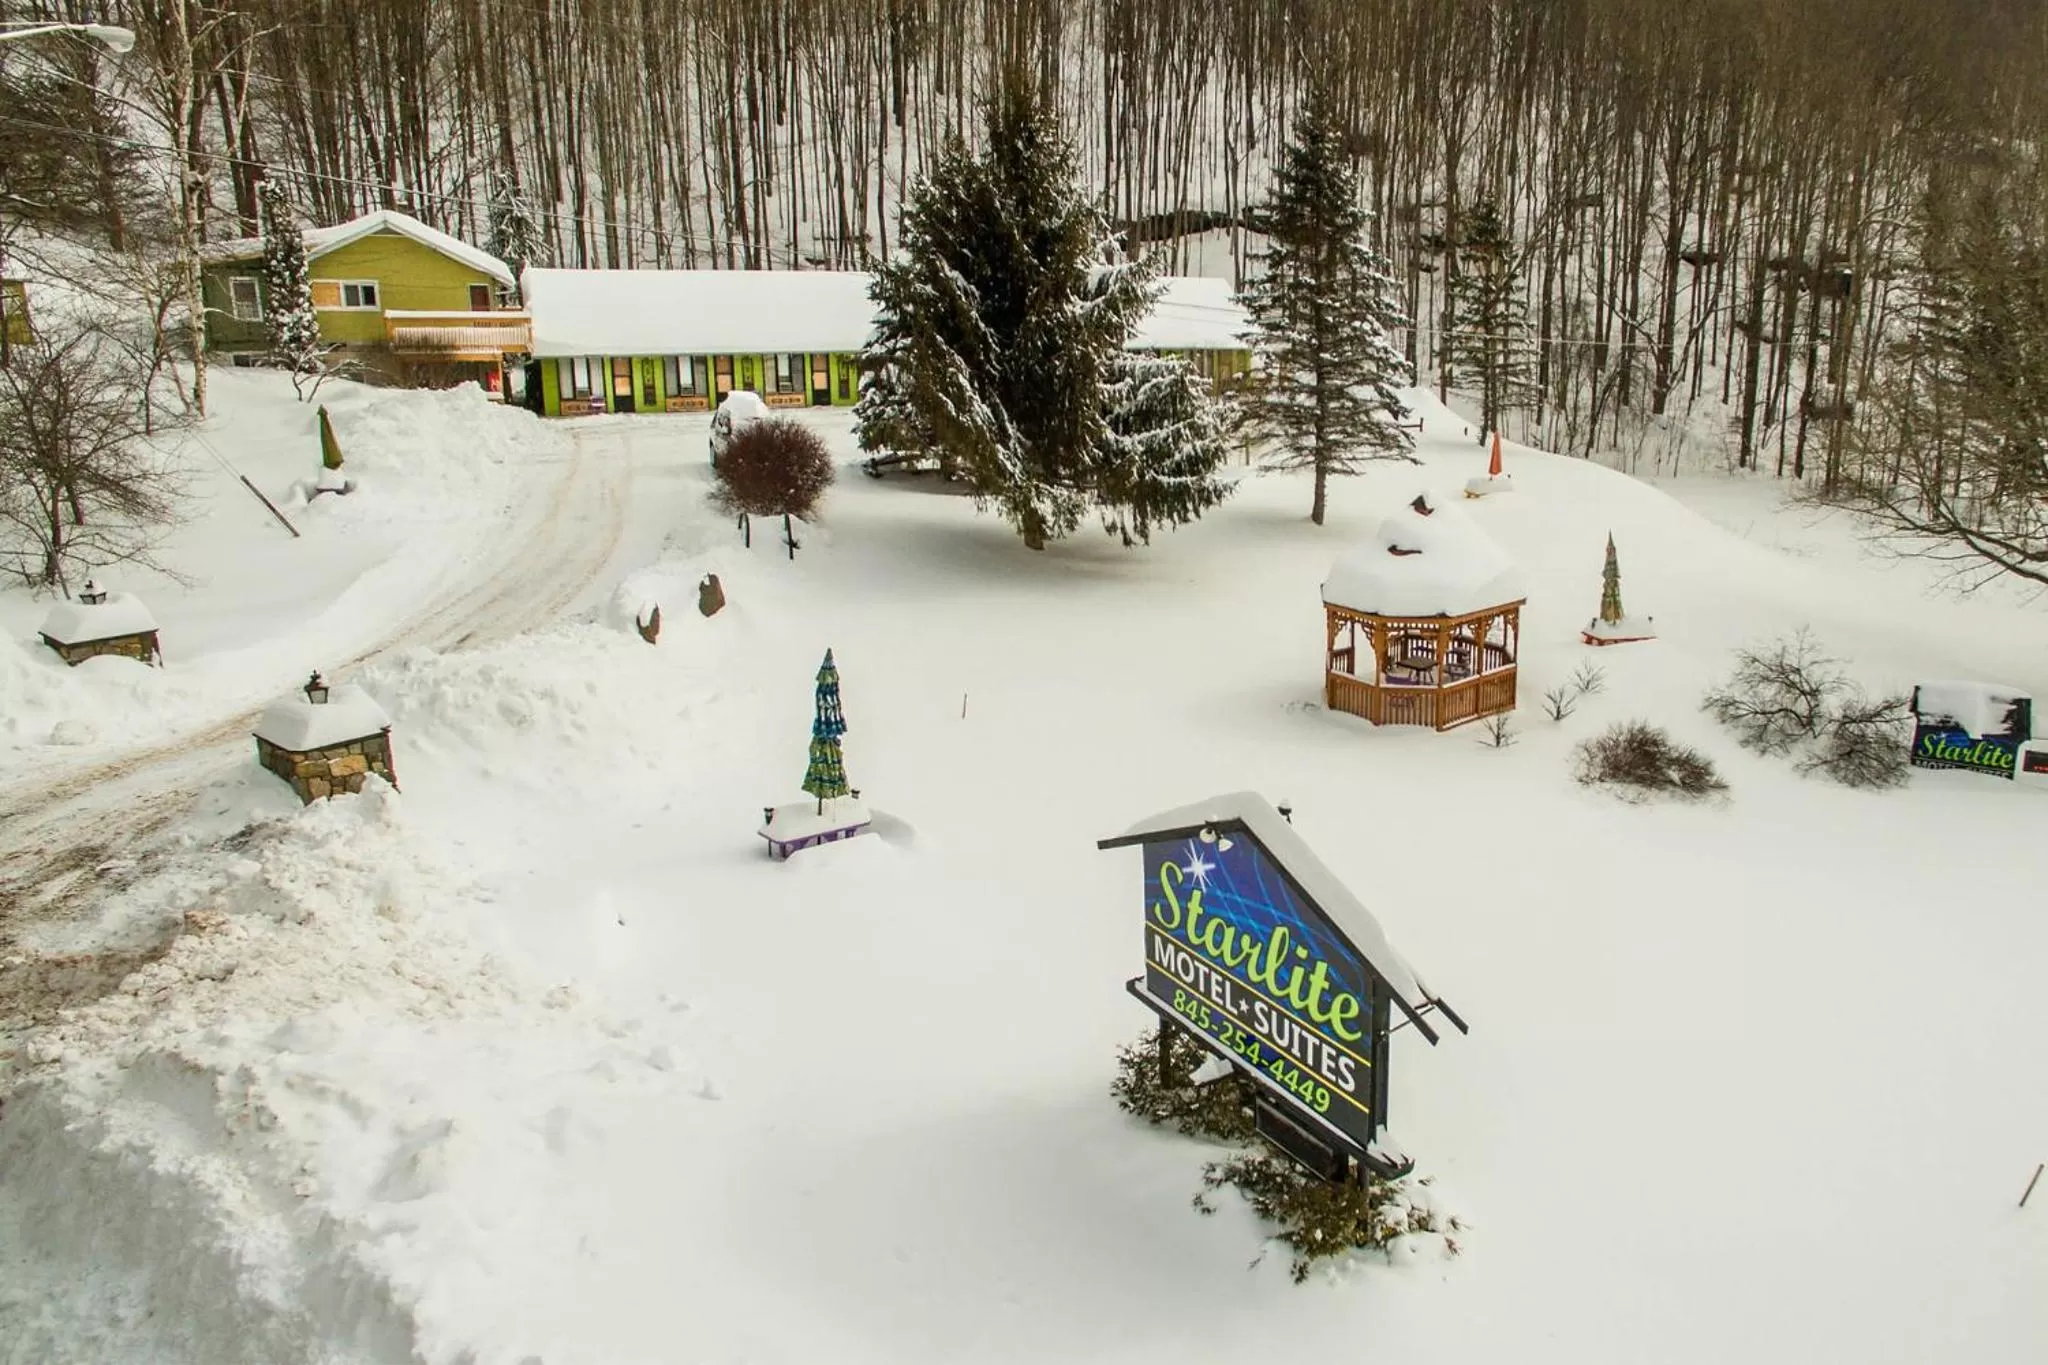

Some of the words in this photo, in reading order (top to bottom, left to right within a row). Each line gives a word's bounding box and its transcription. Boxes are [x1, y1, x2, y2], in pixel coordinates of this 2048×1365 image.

[1918, 733, 2014, 768] Starlite
[1154, 861, 1362, 1041] Starlite
[1154, 934, 1239, 1014] MOTEL
[1253, 1001, 1356, 1093] SUITES
[1172, 989, 1331, 1113] 845-254-4449
